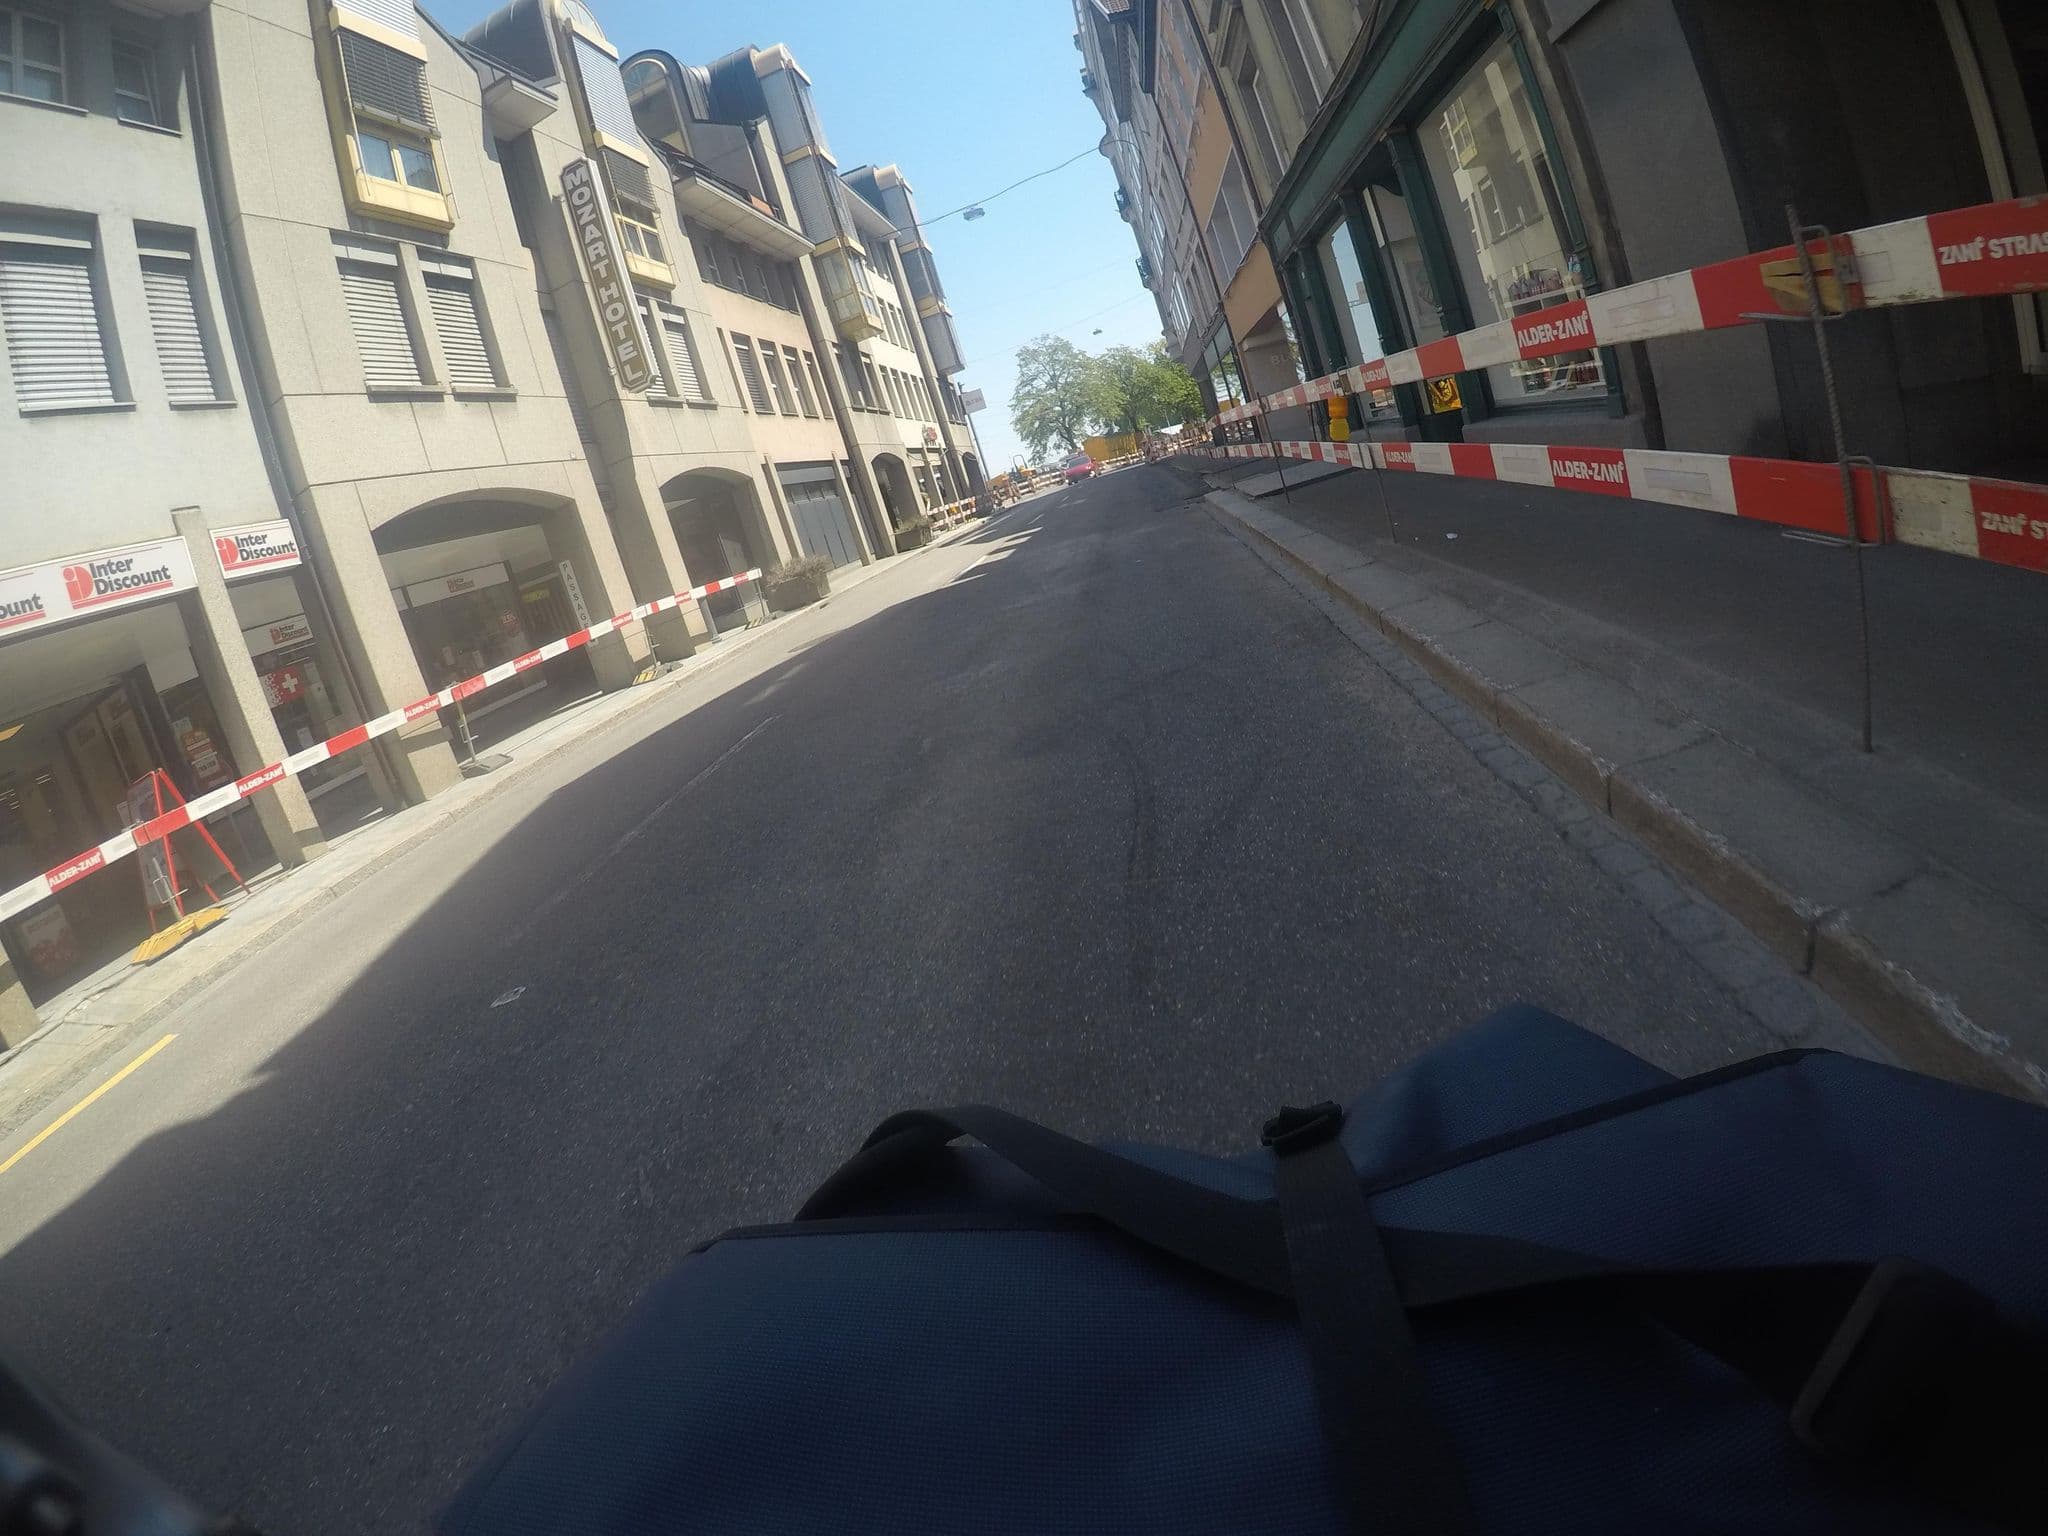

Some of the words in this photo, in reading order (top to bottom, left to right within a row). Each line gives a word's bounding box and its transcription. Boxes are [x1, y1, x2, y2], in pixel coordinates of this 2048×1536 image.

[565, 166, 608, 278] MOZART
[600, 281, 644, 382] HOTEL
[235, 534, 268, 548] Inter
[239, 541, 297, 561] Discount
[89, 558, 134, 579] Inter
[93, 564, 172, 595] Discount
